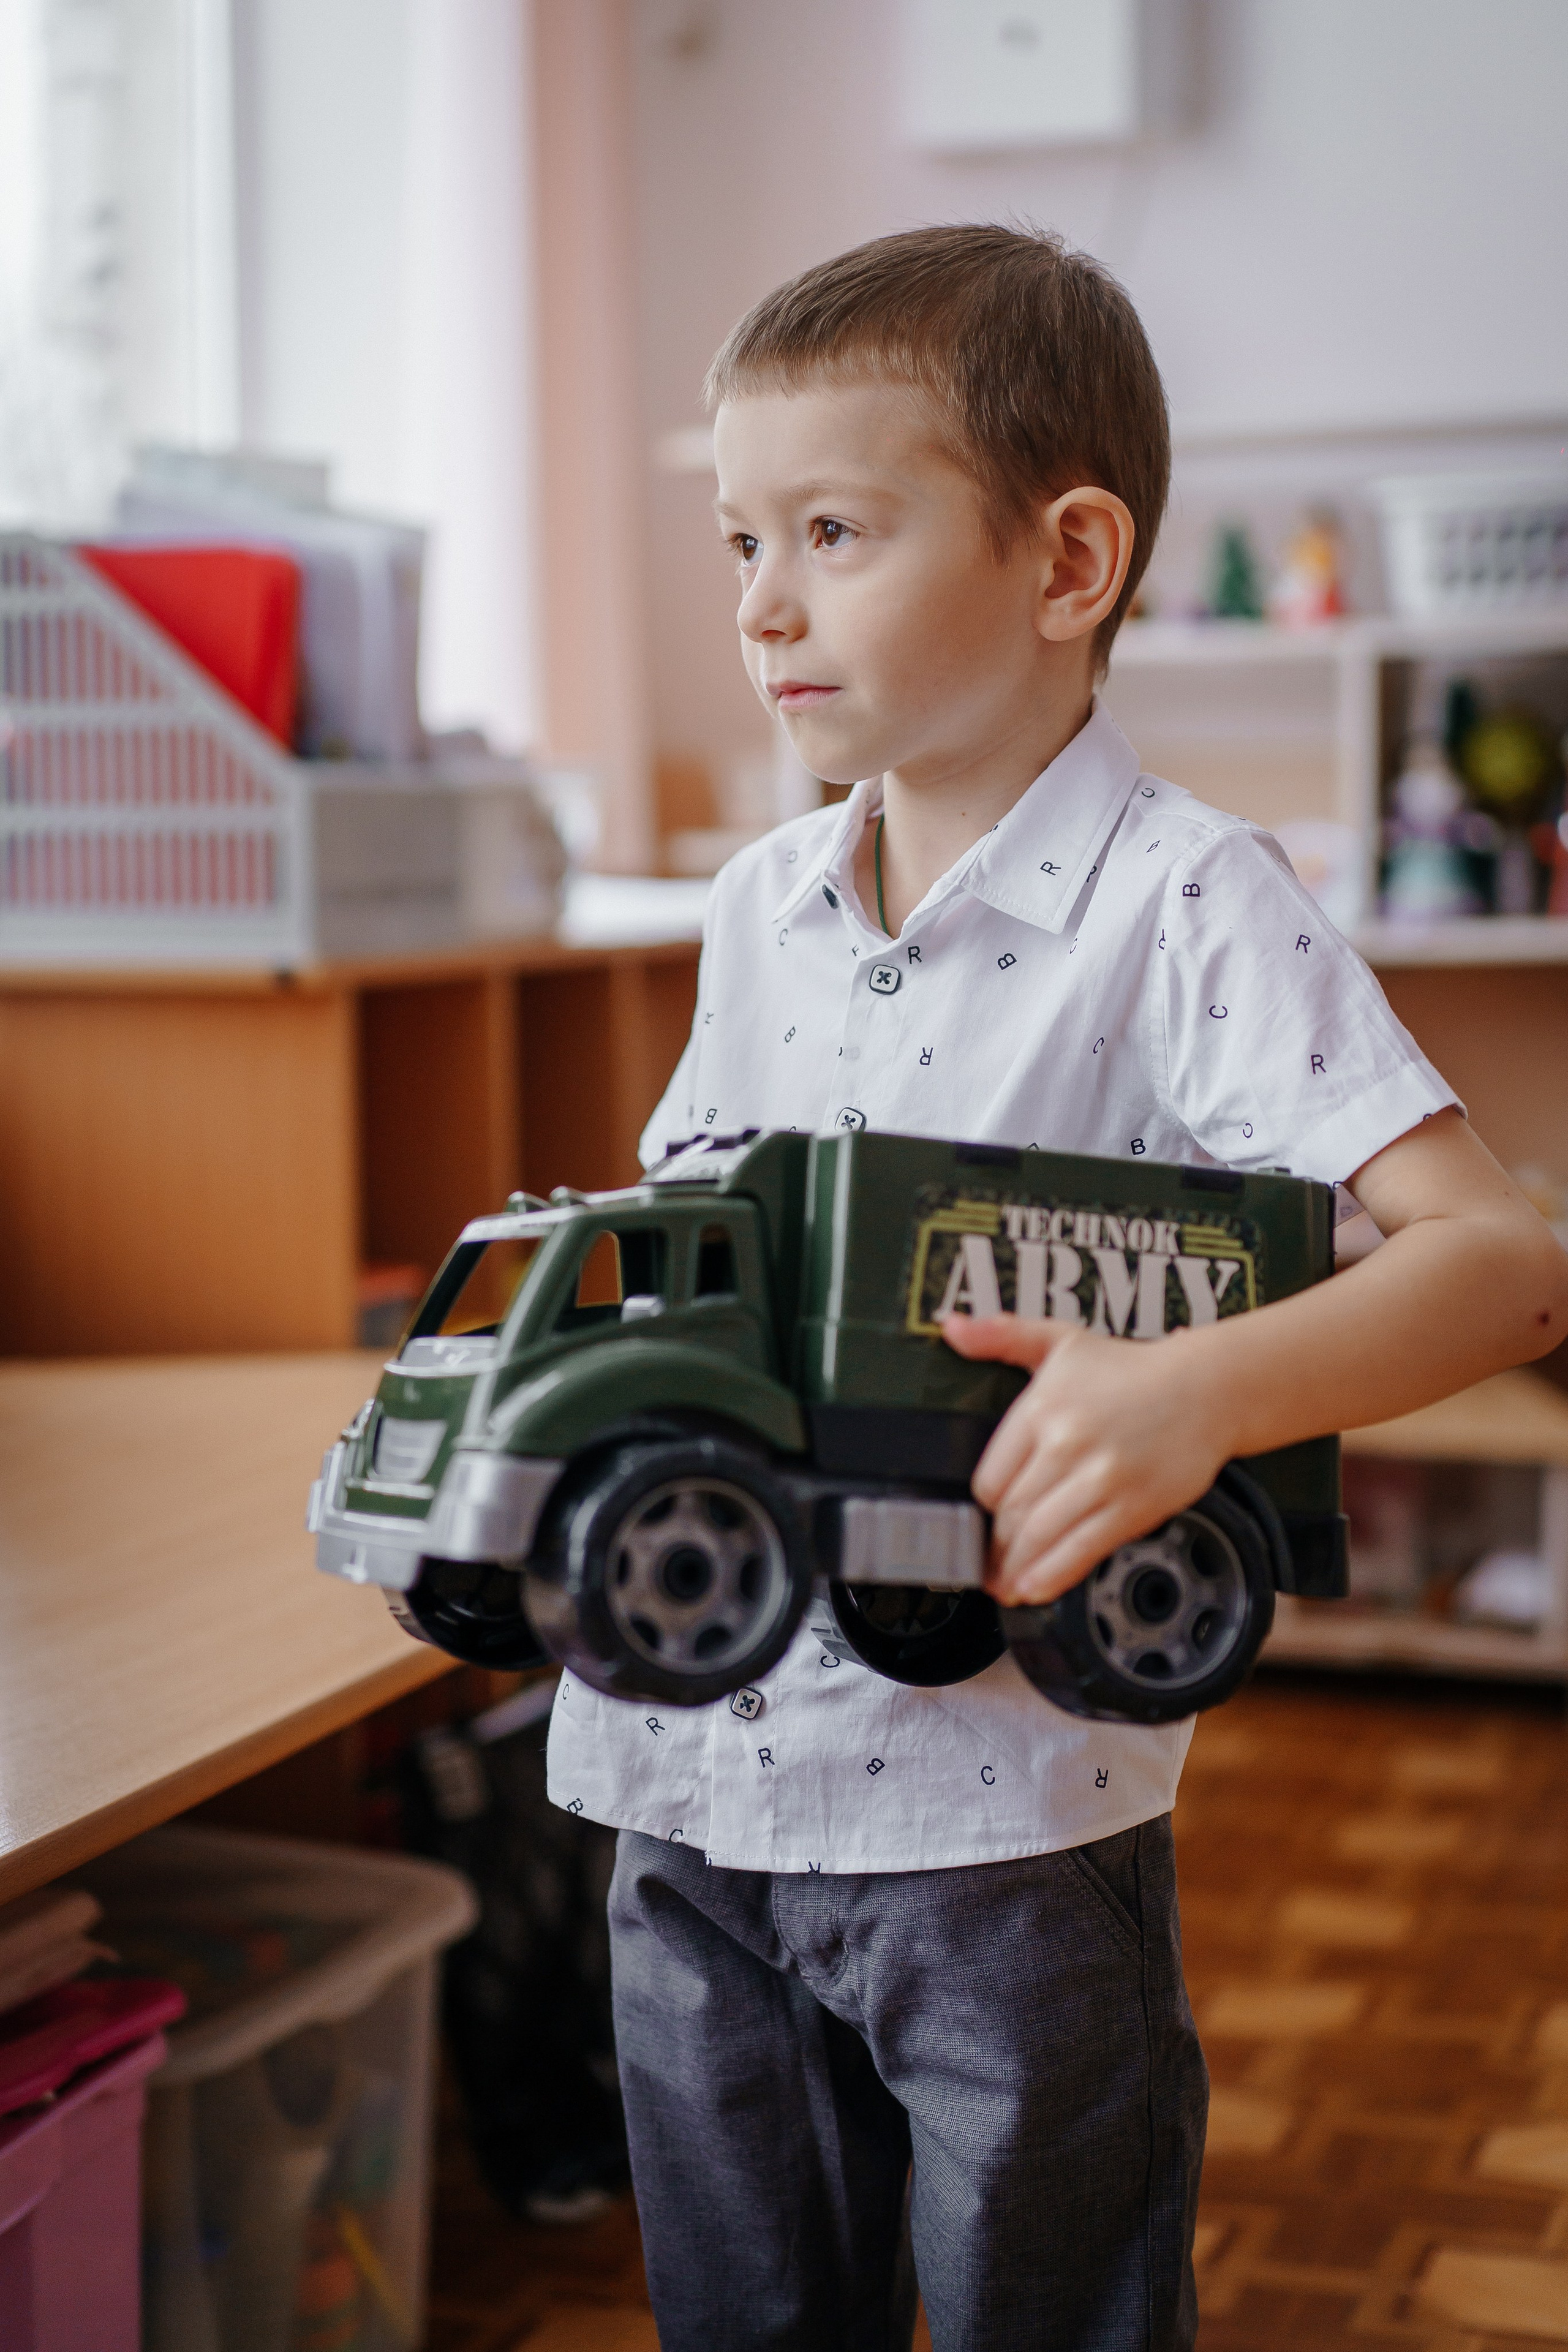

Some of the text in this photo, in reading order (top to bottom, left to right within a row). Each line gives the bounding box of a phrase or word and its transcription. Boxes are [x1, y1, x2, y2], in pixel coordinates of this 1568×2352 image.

[1141, 788, 1155, 798] C
[1039, 861, 1061, 876] R
[1182, 883, 1200, 897] B
[778, 928, 788, 946] C
[1295, 934, 1311, 954] R
[907, 945, 922, 965] R
[997, 952, 1017, 971] B
[1208, 1005, 1228, 1019] C
[784, 1026, 796, 1043] B
[1093, 1036, 1105, 1054] C
[919, 1047, 933, 1066] R
[1311, 1054, 1327, 1075] R
[705, 1108, 718, 1125] B
[1242, 1122, 1253, 1139] C
[1130, 1138, 1146, 1156] B
[1001, 1204, 1180, 1255] TECHNOK
[932, 1233, 1240, 1340] ARMY
[820, 1655, 840, 1668] C
[645, 1717, 666, 1736] R
[758, 1747, 775, 1768] R
[865, 1757, 886, 1776] B
[980, 1765, 995, 1785] C
[1095, 1768, 1109, 1789] R
